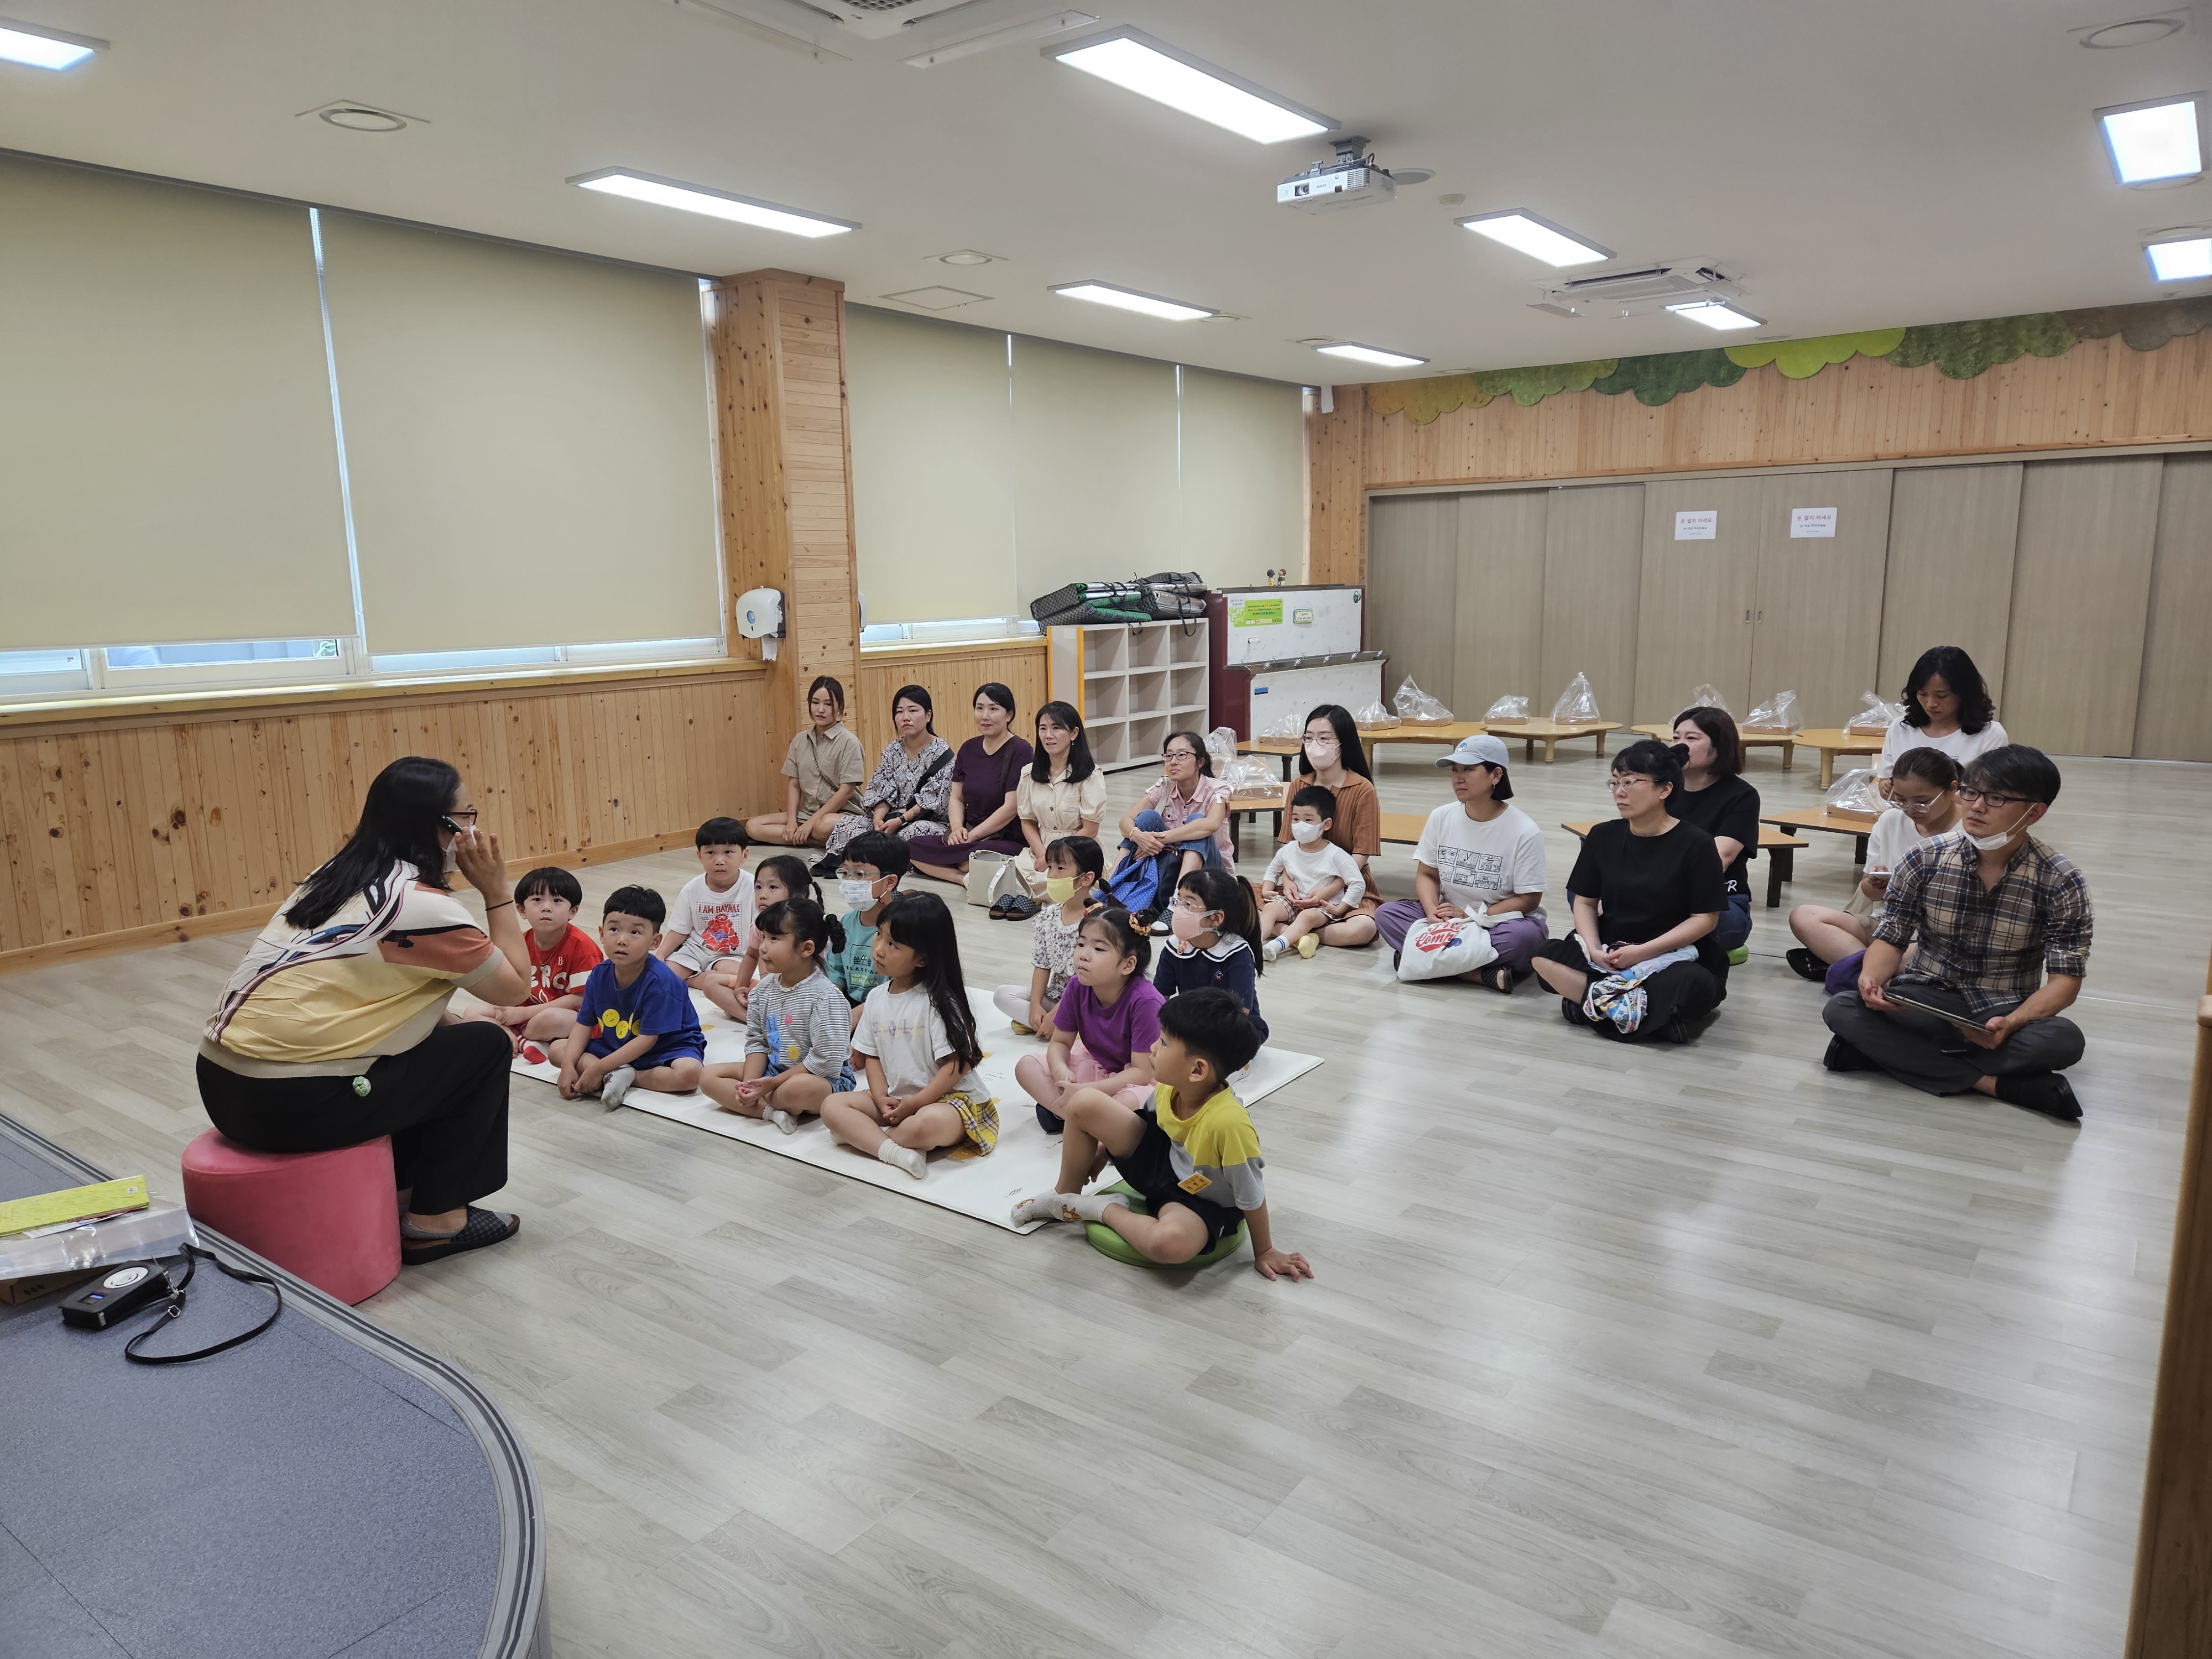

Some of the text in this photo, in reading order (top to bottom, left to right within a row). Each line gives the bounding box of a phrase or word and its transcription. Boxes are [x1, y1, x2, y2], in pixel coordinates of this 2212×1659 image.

[698, 904, 740, 914] I AM BAYMAX
